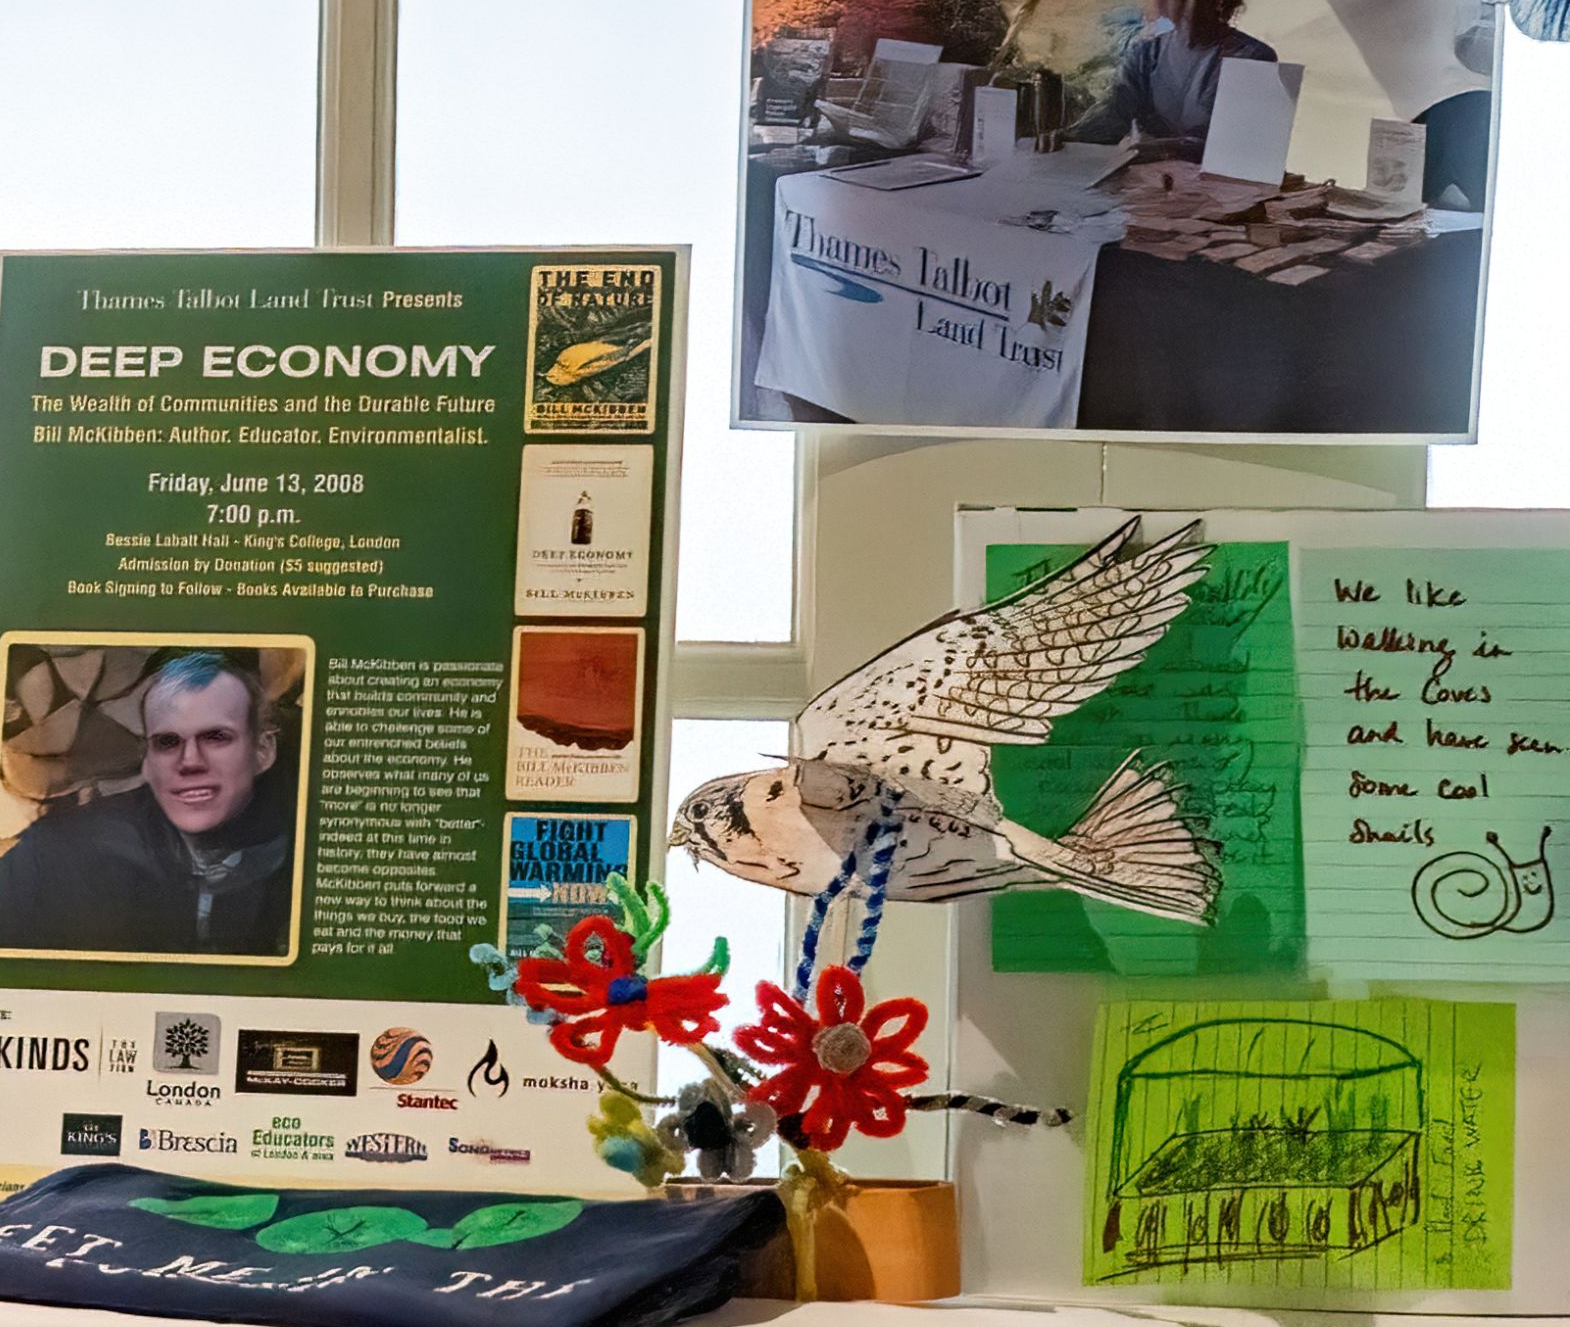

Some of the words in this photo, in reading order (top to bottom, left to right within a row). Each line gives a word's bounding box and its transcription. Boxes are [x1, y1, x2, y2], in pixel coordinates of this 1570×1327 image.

[786, 210, 901, 276] Thames
[919, 246, 1011, 312] Talbot
[539, 271, 588, 287] THE
[603, 271, 654, 288] END
[77, 290, 165, 310] Thames
[176, 289, 240, 309] Talbot
[249, 289, 308, 308] Land
[319, 289, 373, 308] Trust
[382, 291, 463, 308] Presents
[916, 300, 984, 350] Land
[998, 324, 1064, 373] Trust
[39, 346, 183, 378] DEEP
[203, 344, 496, 378] ECONOMY
[32, 394, 64, 412] The
[70, 394, 130, 412] Wealth
[138, 396, 154, 412] of
[160, 395, 278, 413] Communities
[285, 396, 317, 413] and
[325, 396, 351, 413] the
[358, 396, 430, 413] Durable
[437, 396, 495, 413] Future
[33, 426, 61, 444] Bill
[69, 426, 163, 444] McKibben:
[170, 426, 231, 444] Author.
[239, 427, 321, 445] Educator.
[329, 427, 488, 446] Environmentalist.
[148, 473, 213, 495] Friday,
[220, 474, 267, 493] June
[276, 474, 306, 496] 13,
[314, 474, 364, 493] 2008
[207, 504, 250, 524] 7:00
[257, 507, 302, 527] p.m.
[105, 534, 151, 547] Bessie
[156, 534, 197, 547] Labatt
[202, 534, 229, 547] Hall
[244, 534, 284, 550] King's
[289, 535, 345, 550] College,
[350, 536, 400, 549] London
[1334, 578, 1381, 602] We
[1406, 577, 1467, 608] like
[1473, 630, 1513, 658] in
[1344, 669, 1401, 702] the
[1347, 721, 1404, 745] and
[1427, 718, 1489, 748] have
[536, 821, 608, 842] FIGHT
[512, 841, 603, 862] GLOBAL
[146, 1080, 221, 1099] London
[523, 1075, 589, 1090] moksha
[155, 1098, 212, 1107] CANADA
[397, 1093, 458, 1110] Stantec
[158, 1130, 237, 1153] Brescia
[253, 1130, 334, 1148] Educators
